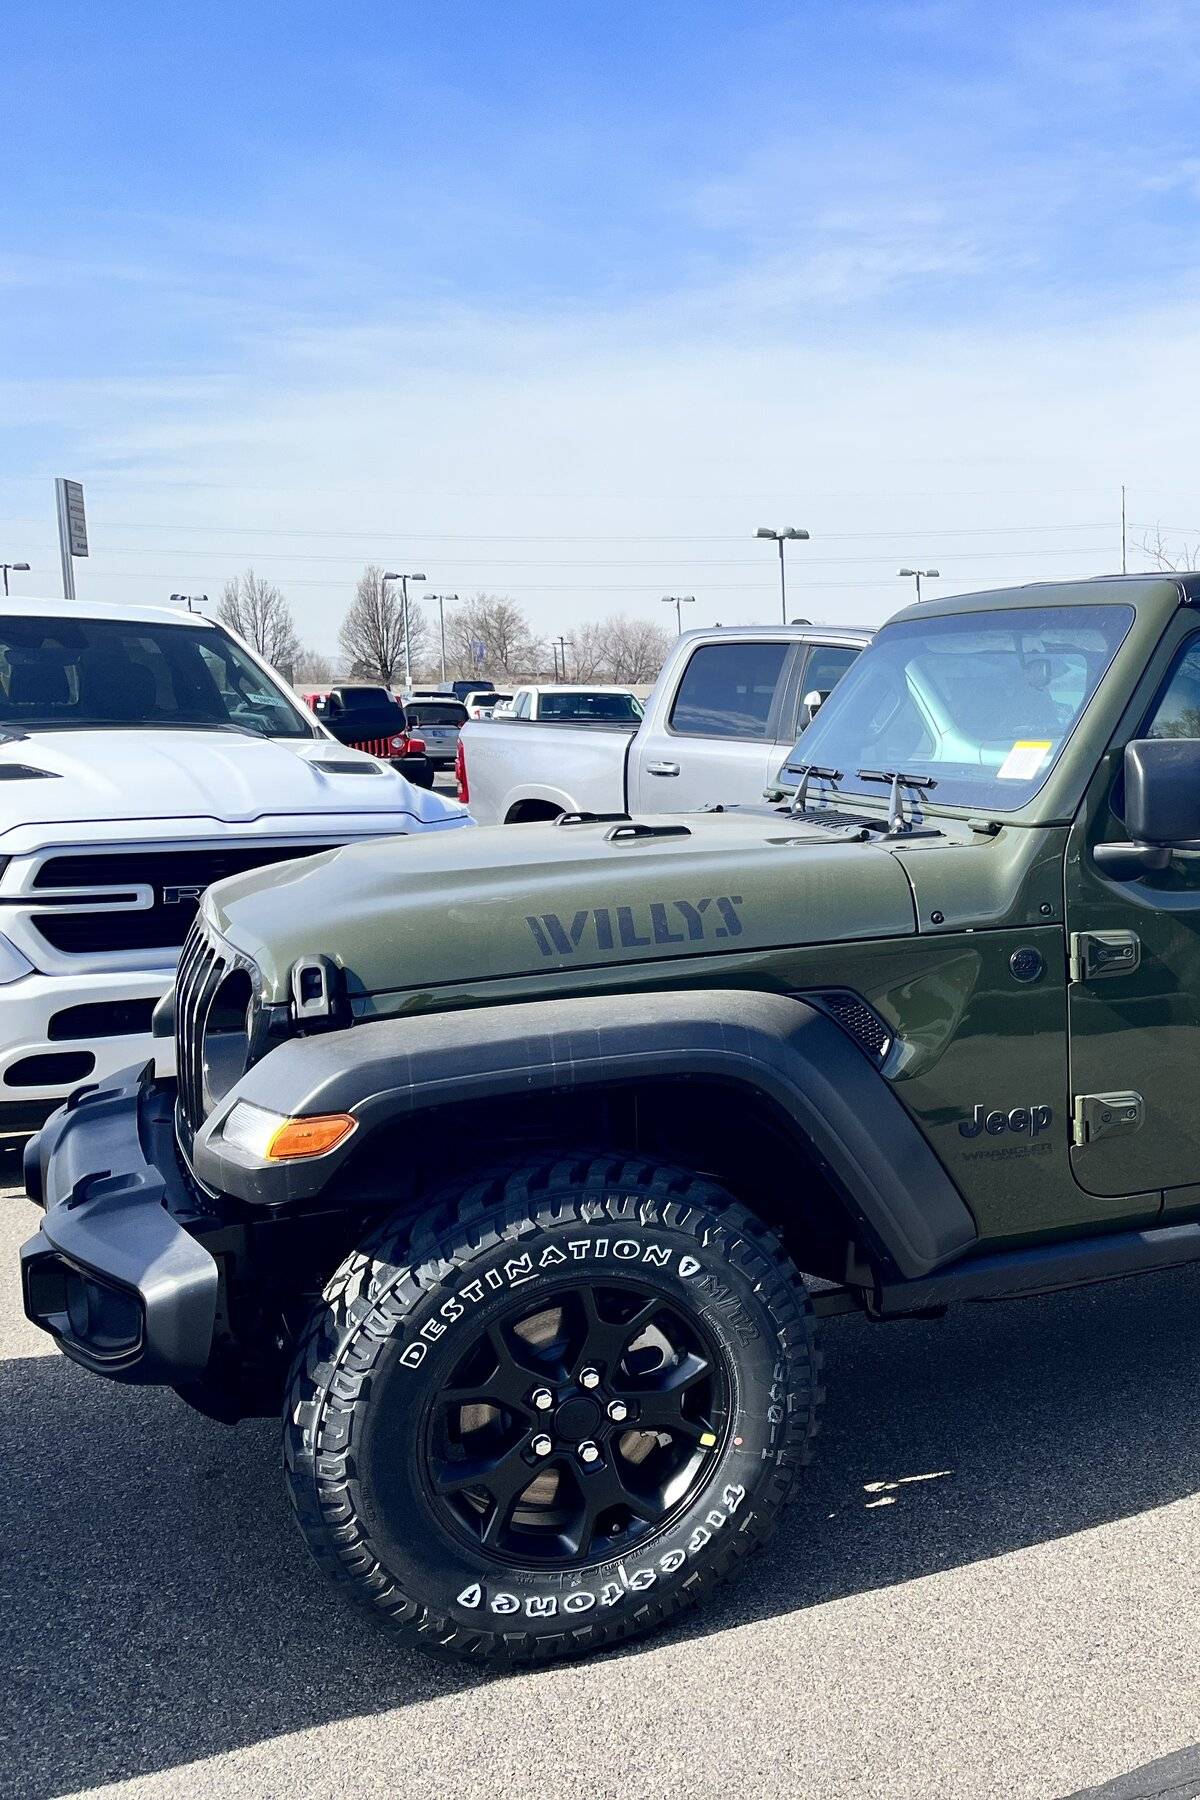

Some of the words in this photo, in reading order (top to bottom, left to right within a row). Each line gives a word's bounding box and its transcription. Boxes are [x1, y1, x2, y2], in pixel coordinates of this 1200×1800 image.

[524, 895, 744, 957] WILLYS
[958, 1104, 1053, 1138] Jeep
[399, 1239, 673, 1369] DESTINATION
[490, 1483, 746, 1618] Firestone
